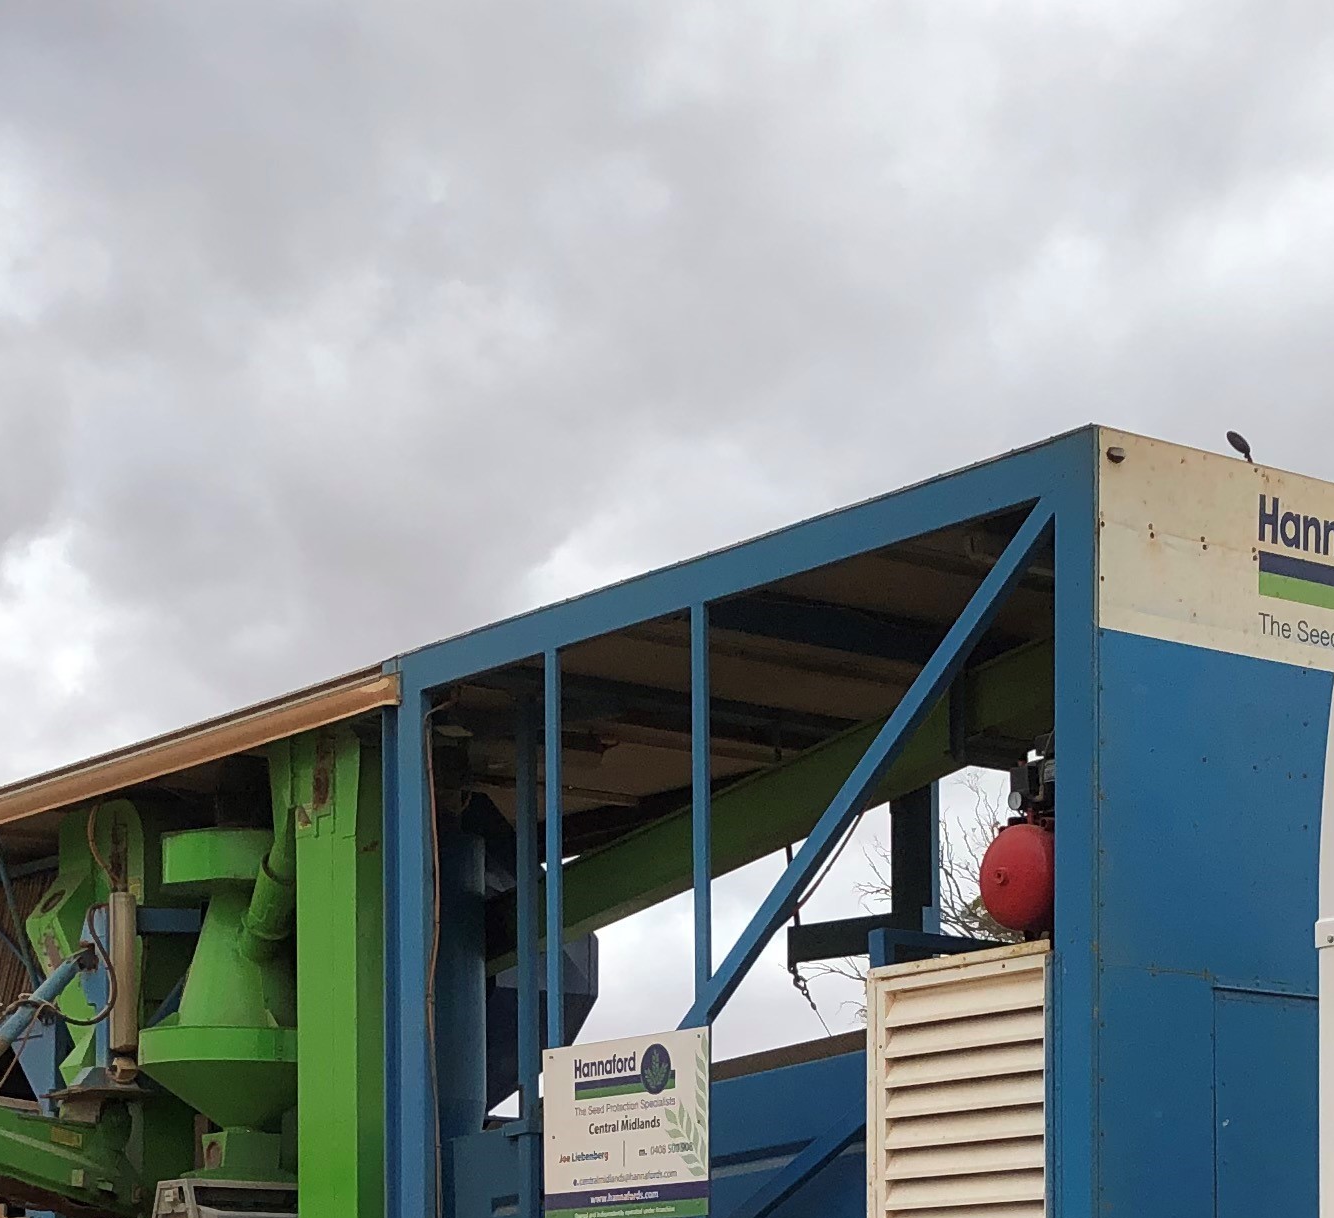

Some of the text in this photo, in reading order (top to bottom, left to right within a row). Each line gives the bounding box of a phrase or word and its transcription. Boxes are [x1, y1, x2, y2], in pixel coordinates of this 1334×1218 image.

[1258, 612, 1291, 639] The
[574, 1051, 636, 1079] Hannaford
[575, 1097, 676, 1116] The Seed Protection Specialists
[589, 1116, 661, 1135] Central Midlands
